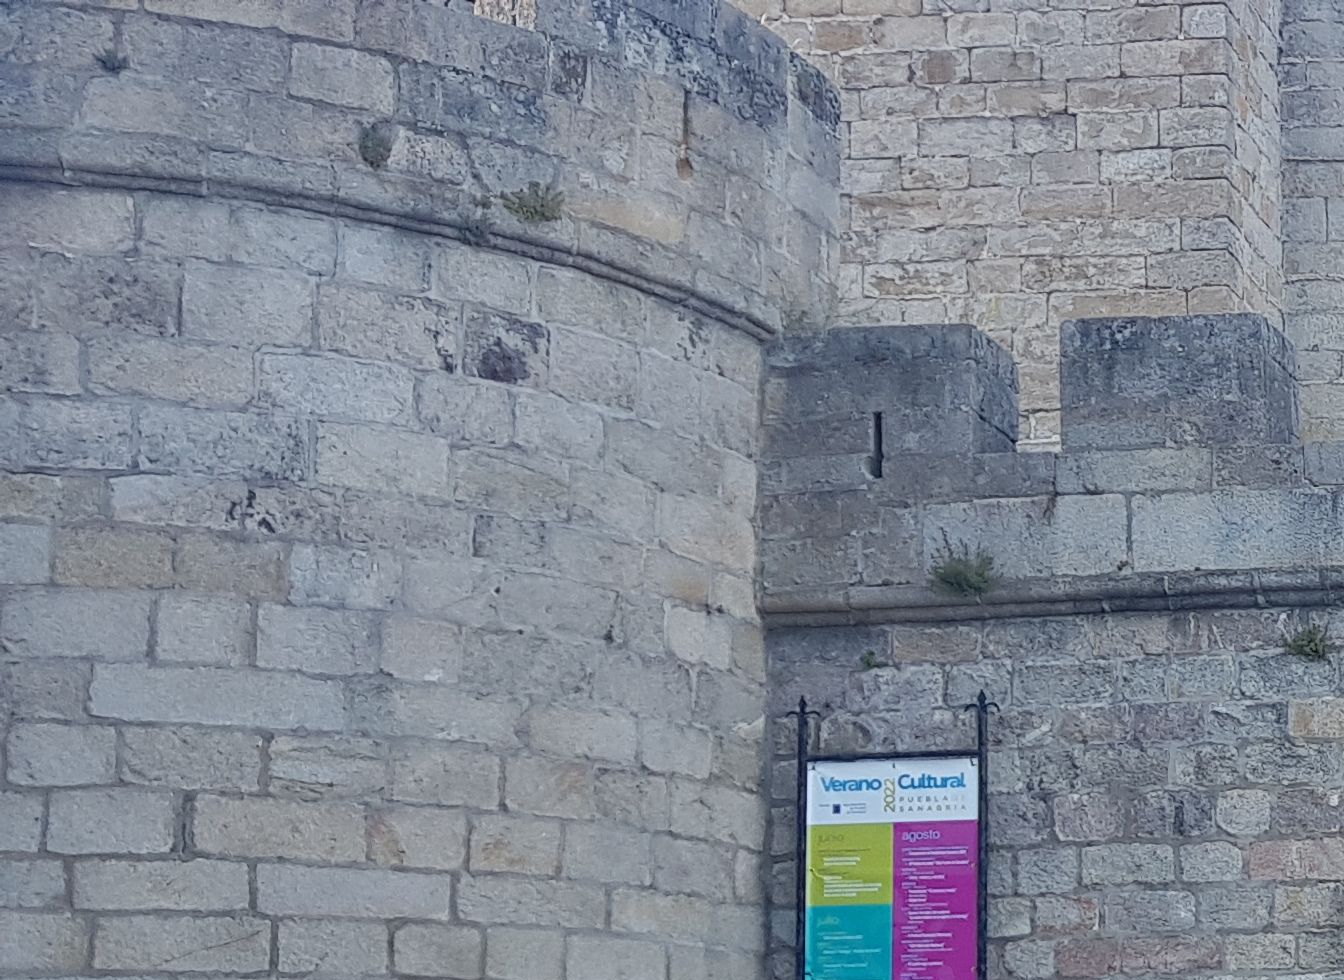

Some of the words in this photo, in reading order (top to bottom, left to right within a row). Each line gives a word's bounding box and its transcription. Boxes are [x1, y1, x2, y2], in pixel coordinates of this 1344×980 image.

[820, 776, 882, 792] Verano
[898, 772, 967, 790] Cultural
[884, 777, 896, 813] 2022
[899, 795, 949, 803] PUEBLA
[899, 804, 967, 812] SANABRIA
[902, 829, 941, 842] agosto
